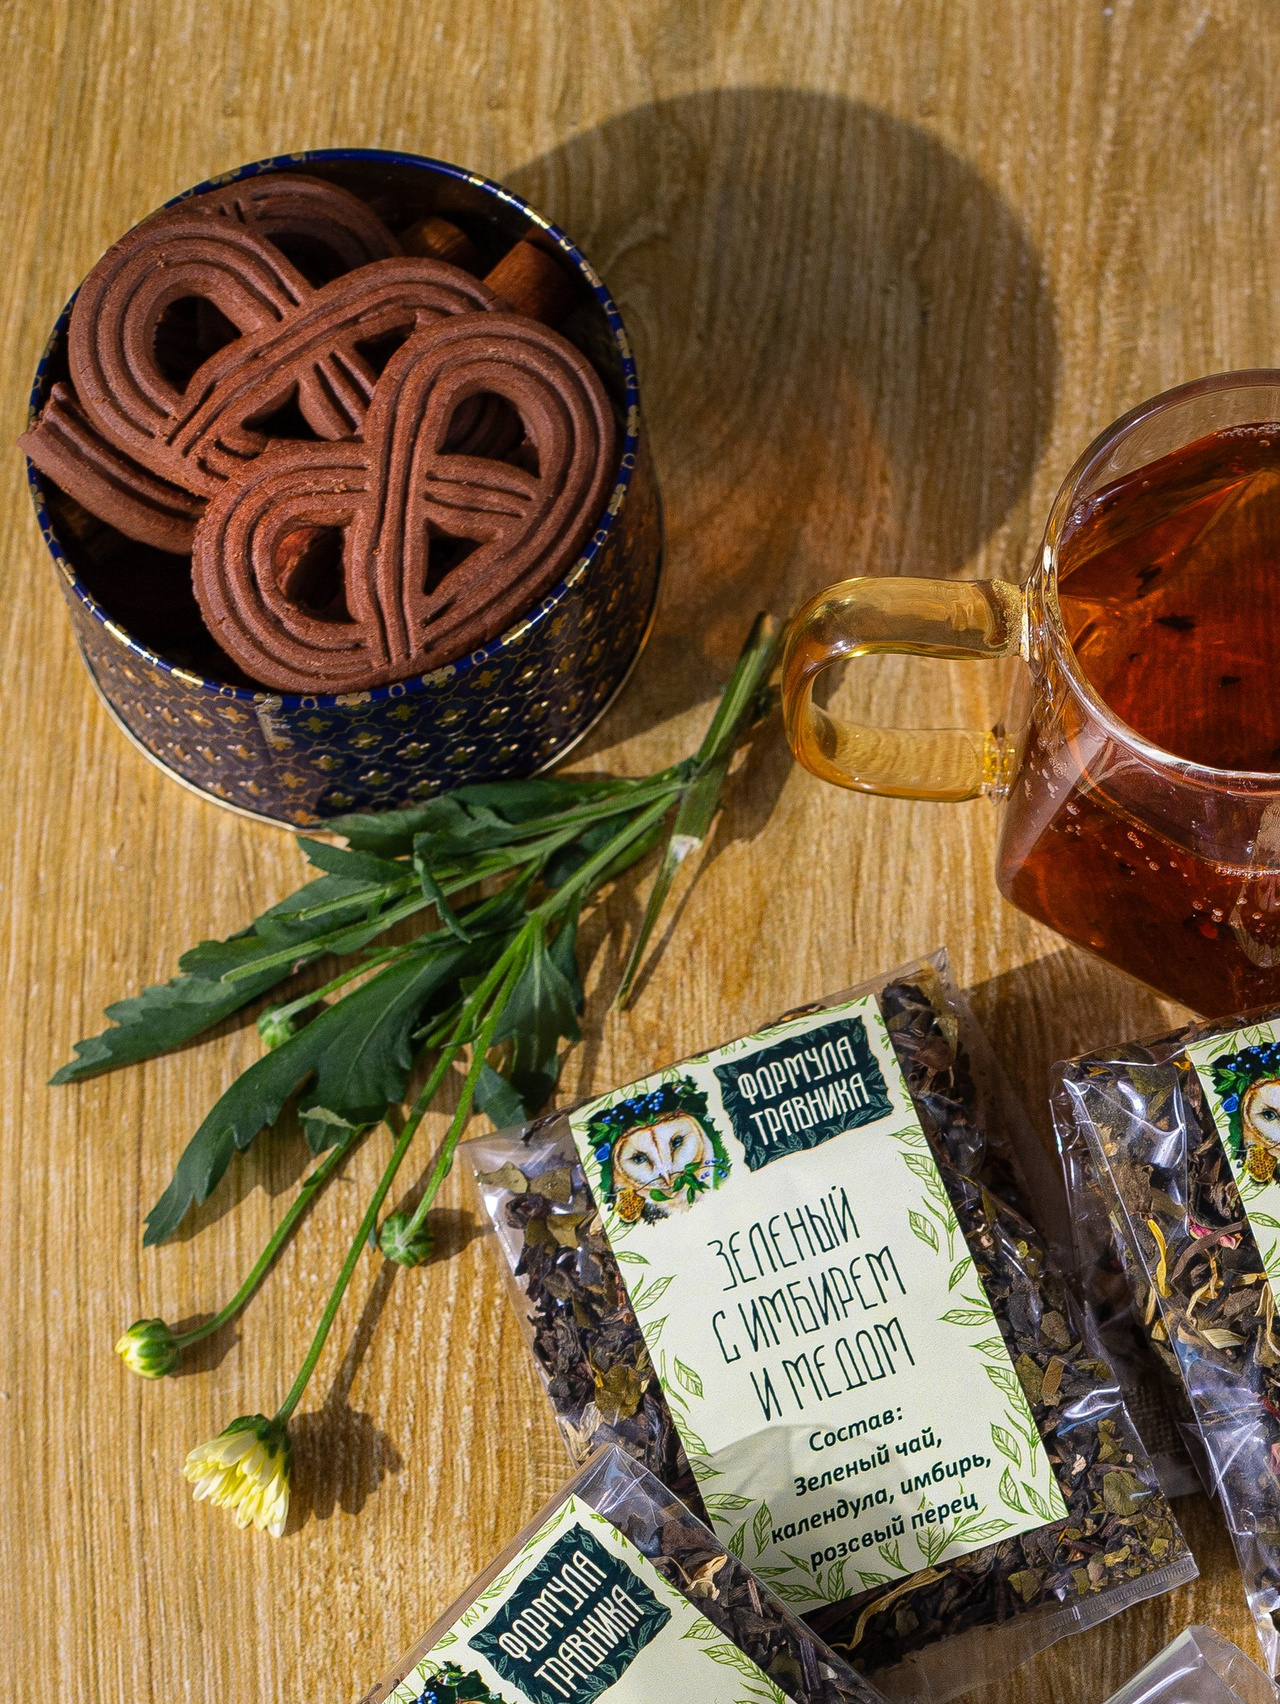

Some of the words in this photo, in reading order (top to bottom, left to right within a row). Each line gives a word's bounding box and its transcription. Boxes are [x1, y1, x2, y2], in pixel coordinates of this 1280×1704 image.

[738, 1036, 856, 1103] ФОРМУЛА
[749, 1073, 870, 1146] ТРАВНИКА
[708, 1185, 861, 1291] ЗЕЛЕНЫЙ
[712, 1309, 741, 1363] С
[738, 1246, 908, 1353] ИМБИРЕМ
[750, 1366, 788, 1421] И
[782, 1316, 916, 1410] МЕДОМ
[794, 1444, 890, 1496] Зеленый
[895, 1427, 942, 1456] чай,
[809, 1407, 903, 1451] Состав:
[772, 1488, 895, 1544] календула,
[900, 1454, 991, 1495] имбирь,
[911, 1493, 979, 1530] перец
[498, 1550, 608, 1663] ФОРМУЛА
[534, 1584, 645, 1699] ТРАВНИКА
